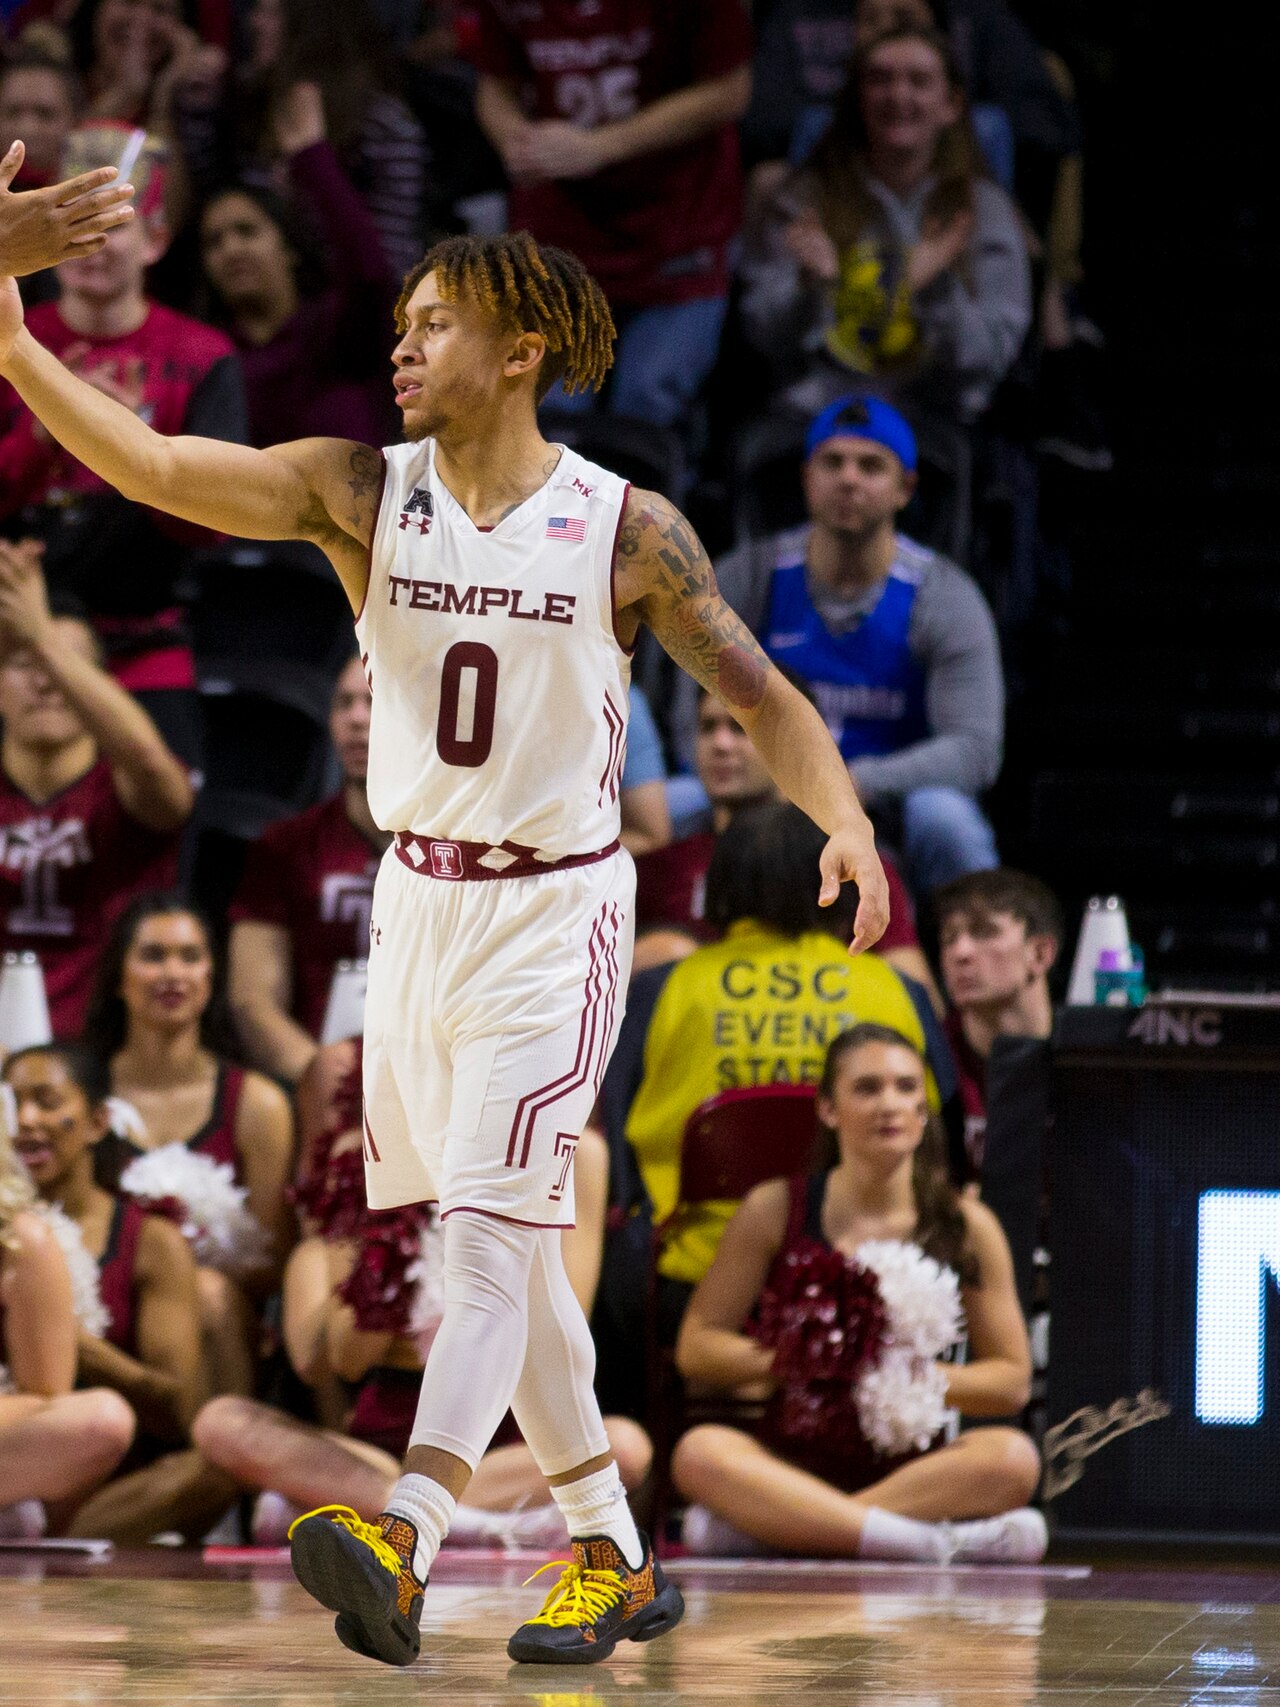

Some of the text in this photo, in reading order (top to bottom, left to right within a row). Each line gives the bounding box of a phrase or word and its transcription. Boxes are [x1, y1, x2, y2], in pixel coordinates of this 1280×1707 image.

[572, 477, 593, 499] MK
[388, 575, 577, 625] TEMPLE
[436, 640, 499, 768] 0
[722, 960, 848, 1003] CSC
